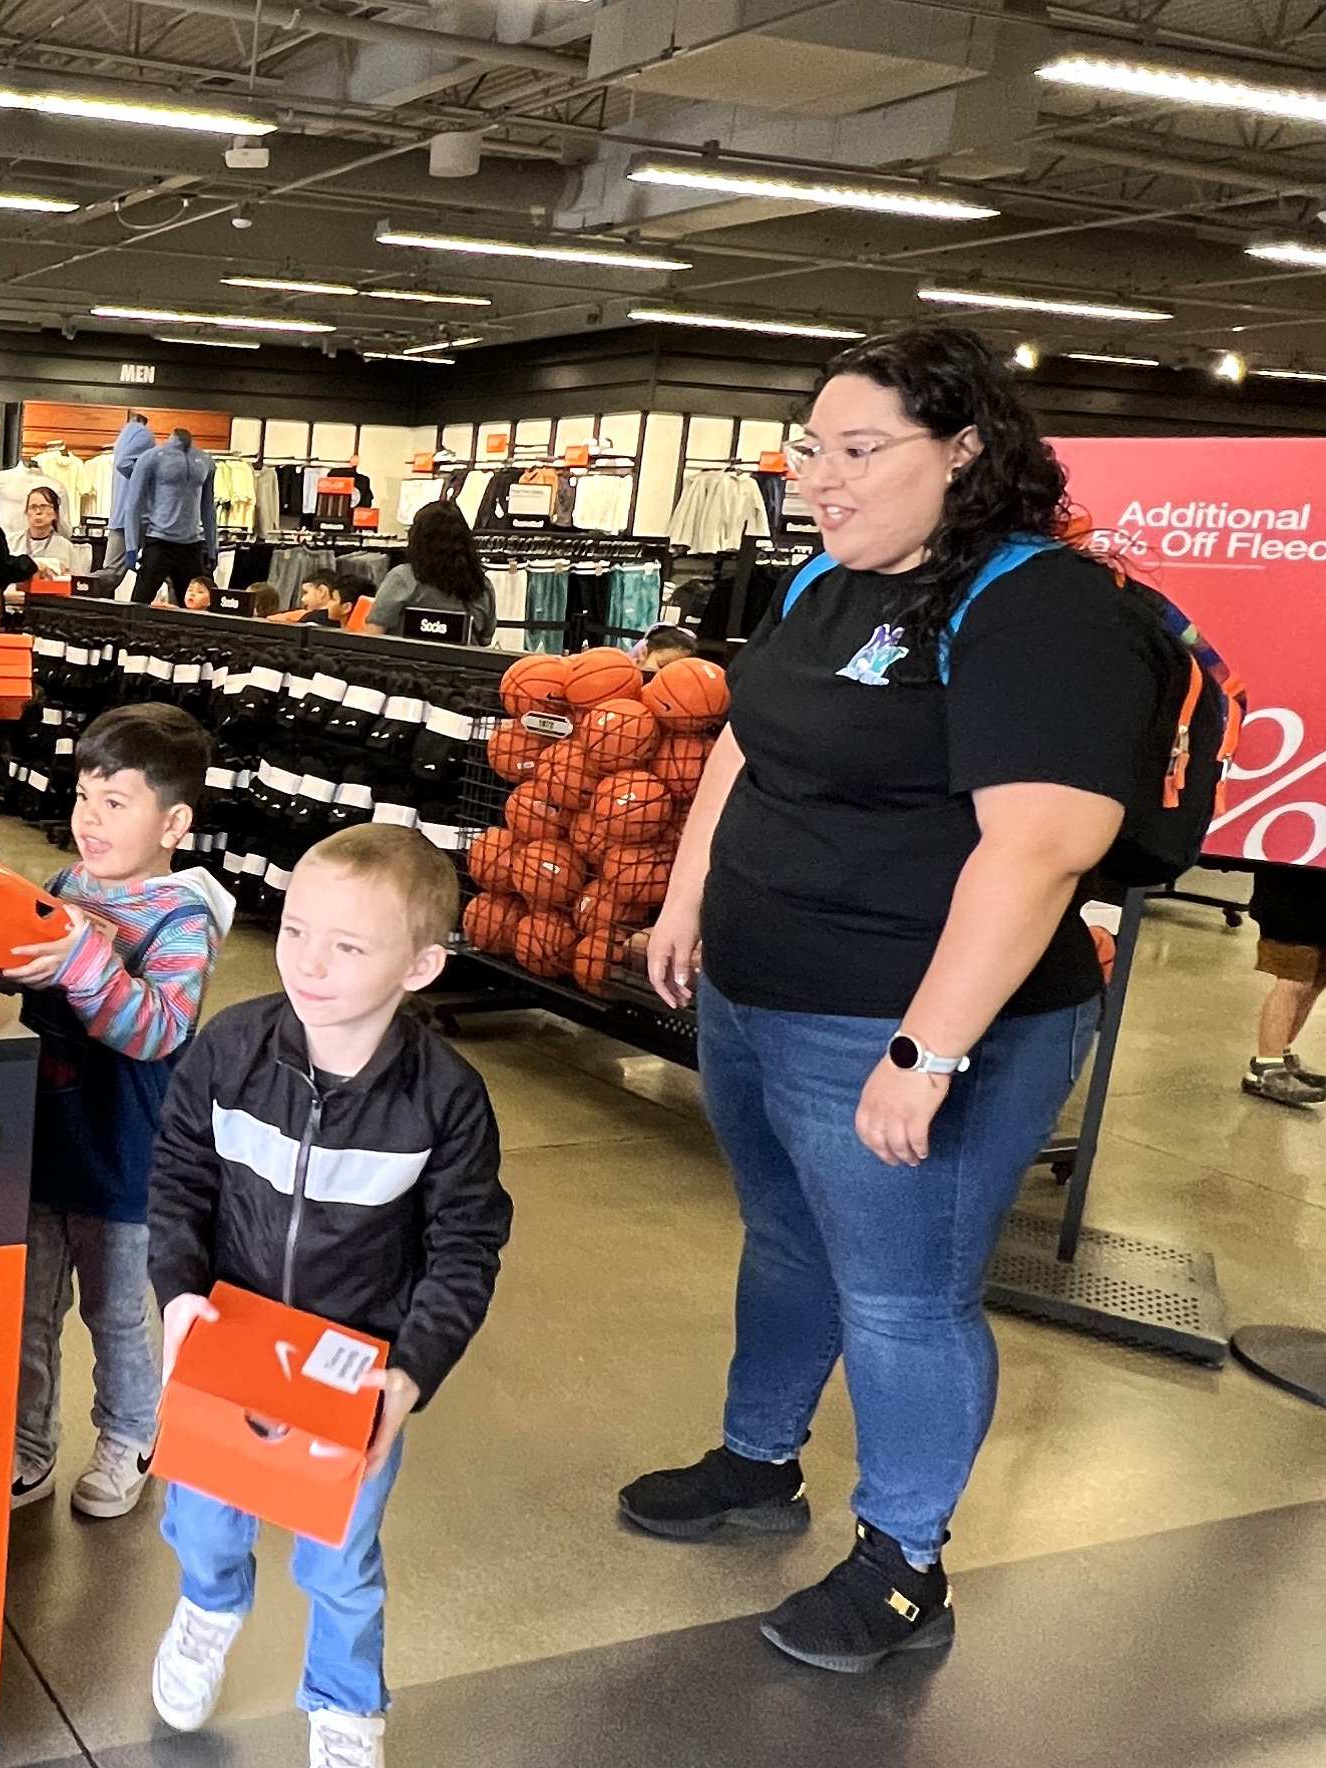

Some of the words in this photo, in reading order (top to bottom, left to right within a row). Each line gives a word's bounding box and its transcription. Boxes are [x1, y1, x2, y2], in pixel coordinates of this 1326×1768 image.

[120, 364, 155, 383] MEN
[1117, 501, 1310, 530] Additional
[1161, 530, 1219, 557] Off
[420, 618, 447, 634] Socks
